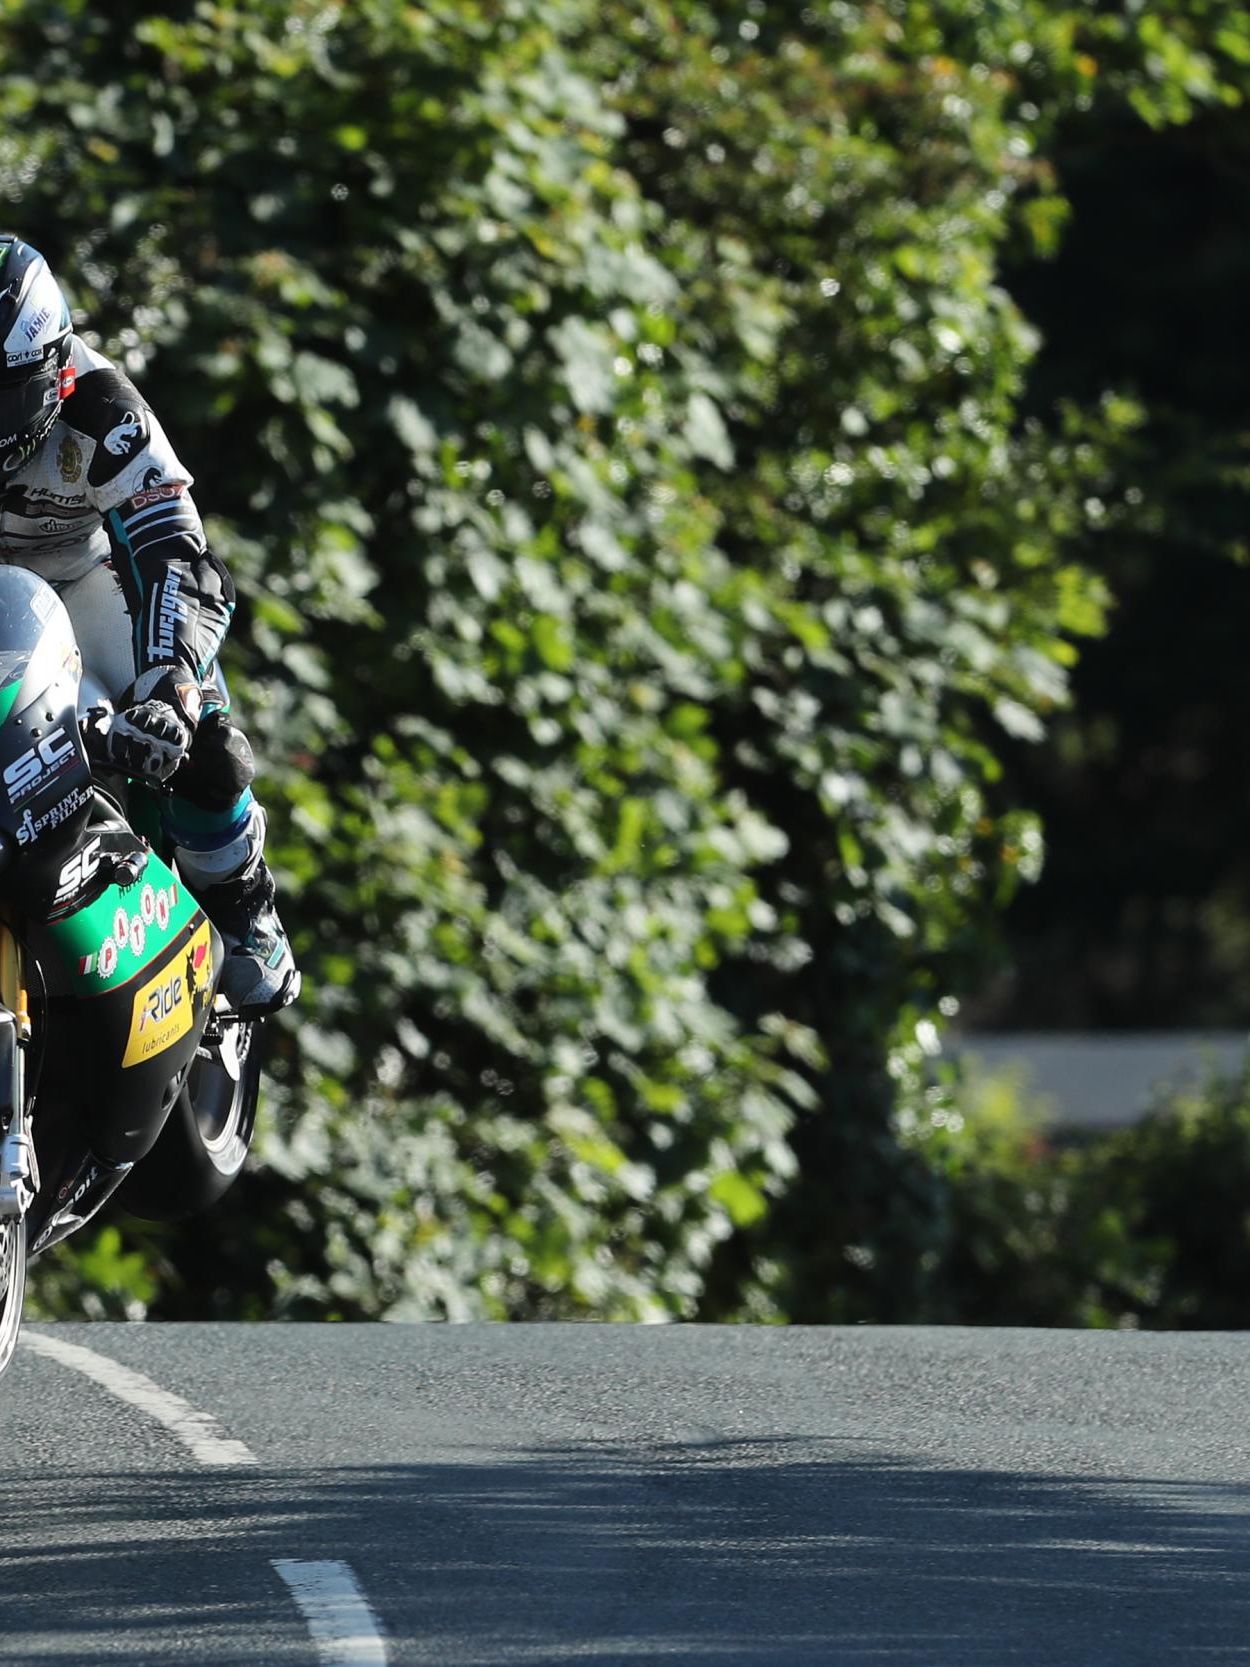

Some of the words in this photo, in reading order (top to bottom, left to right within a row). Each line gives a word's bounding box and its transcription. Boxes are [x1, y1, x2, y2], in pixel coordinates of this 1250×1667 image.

[25, 307, 50, 342] JAMIE
[3, 727, 75, 796] SC
[10, 747, 76, 804] PROJECT
[34, 787, 79, 832] SPRINT
[50, 785, 94, 830] FILTER
[55, 836, 101, 899] SC
[102, 891, 167, 973] PATON
[142, 1023, 180, 1054] lubricants
